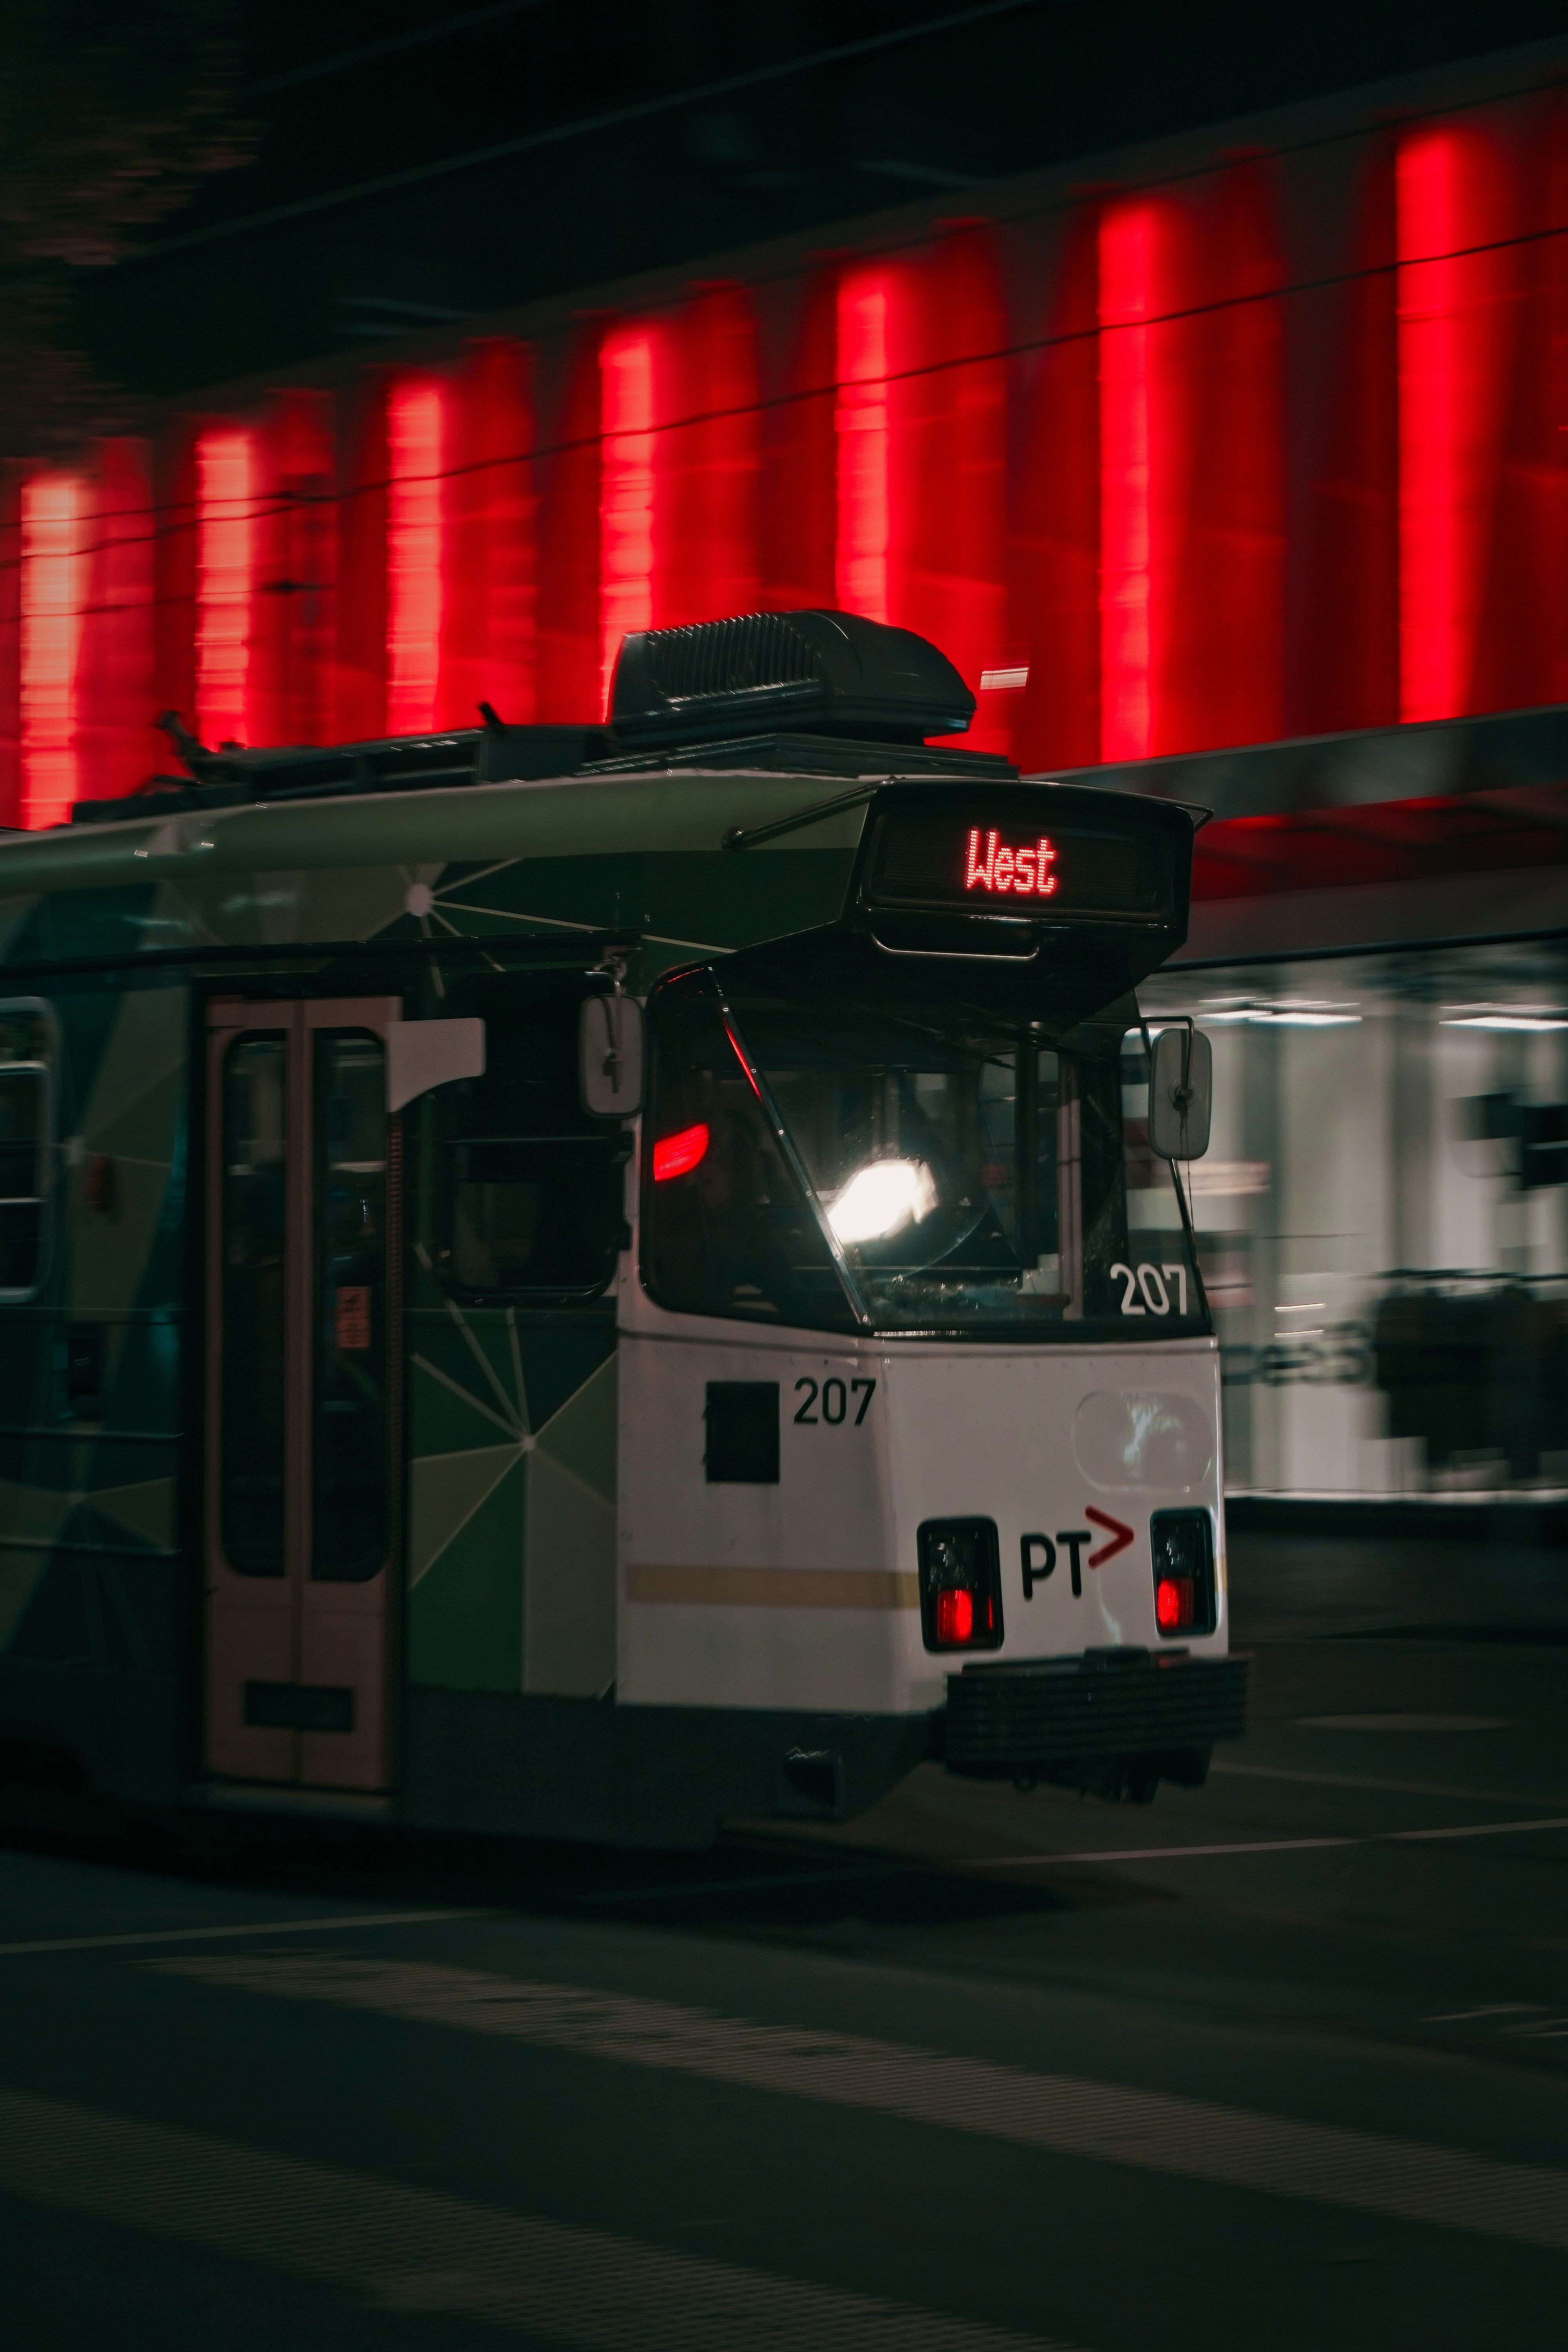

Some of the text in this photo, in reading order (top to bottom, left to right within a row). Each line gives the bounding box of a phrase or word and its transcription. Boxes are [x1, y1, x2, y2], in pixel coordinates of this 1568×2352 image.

[965, 828, 1058, 894] West
[1110, 1262, 1187, 1315] 207
[793, 1376, 877, 1426] 207
